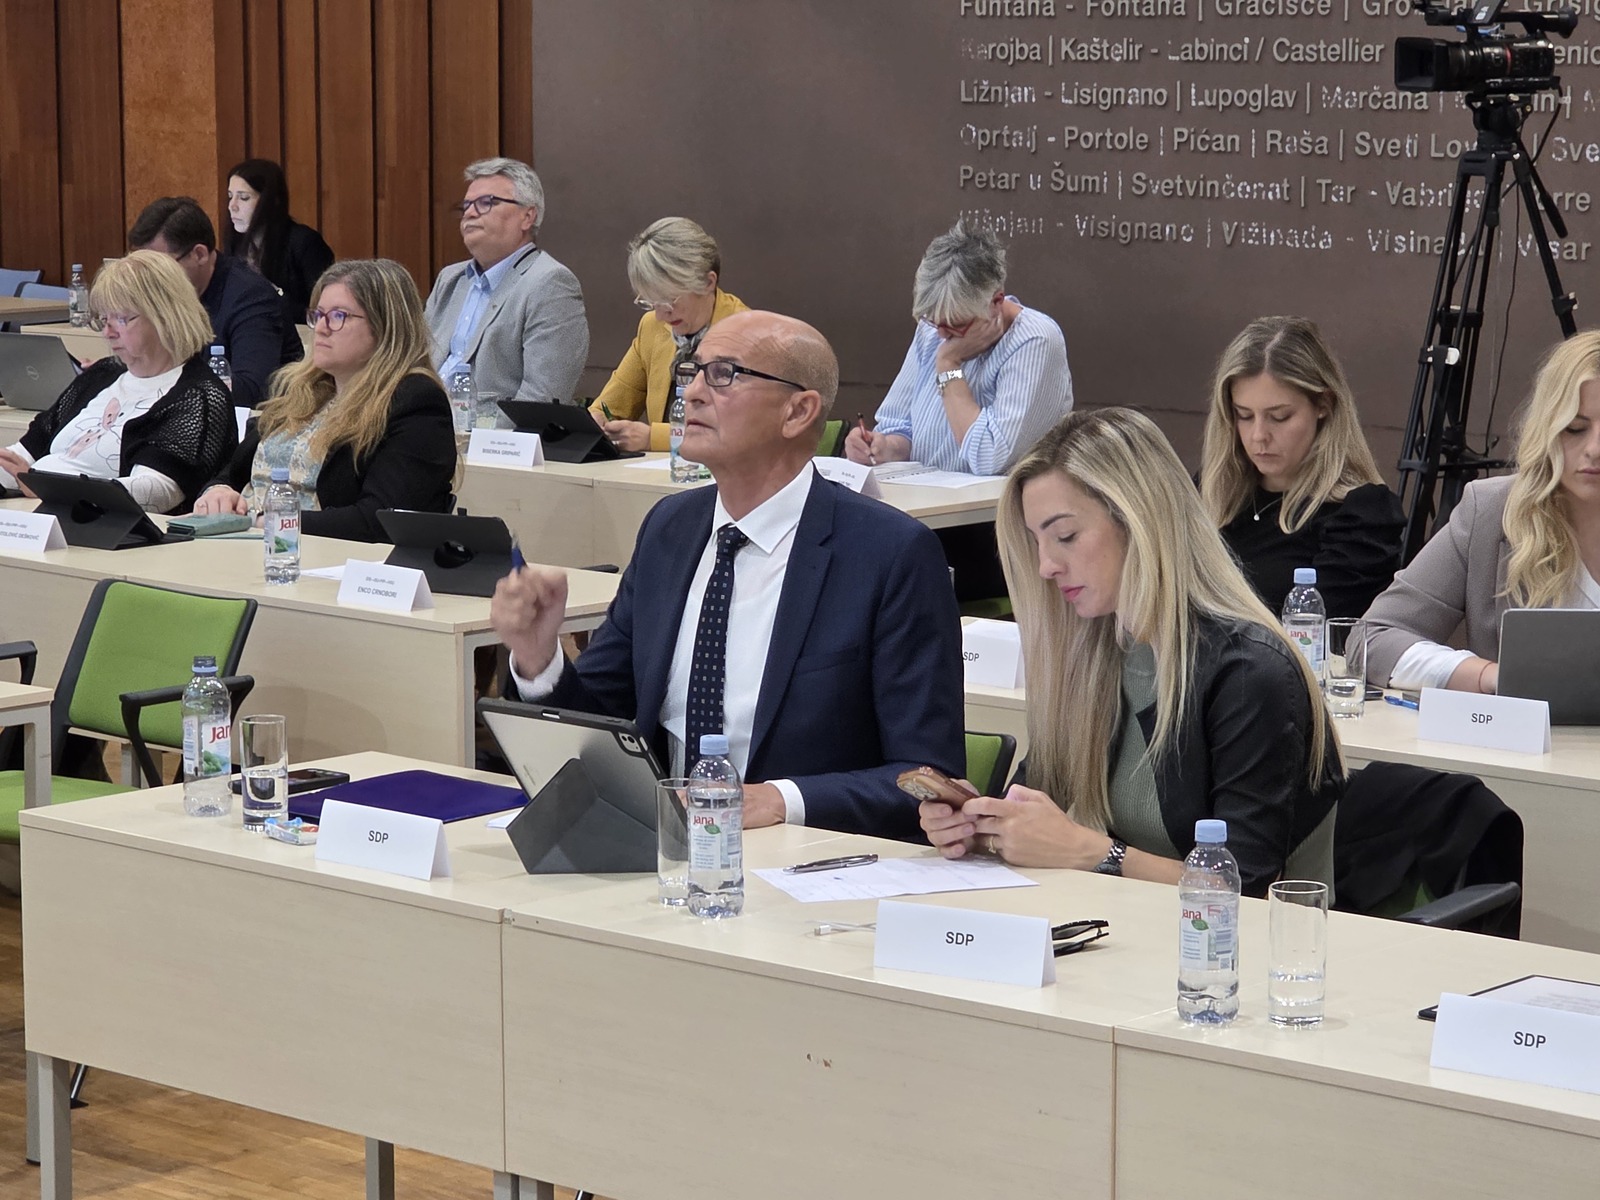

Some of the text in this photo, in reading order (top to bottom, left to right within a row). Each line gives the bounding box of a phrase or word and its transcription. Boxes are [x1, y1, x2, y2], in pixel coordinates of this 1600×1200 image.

[1087, 0, 1186, 16] Fontana
[1061, 37, 1143, 61] Kaštelir
[1273, 37, 1385, 63] Castellier
[960, 80, 1036, 107] Ližnjan
[1061, 82, 1168, 110] Lisignano
[1191, 83, 1297, 113] Lupoglav
[1322, 85, 1429, 110] Marčana
[960, 123, 1037, 153] Oprtalj
[1064, 126, 1149, 150] Portole
[1173, 127, 1240, 152] Pićan
[1266, 129, 1328, 155] Raša
[1355, 131, 1418, 158] Sveti
[959, 165, 1020, 189] Petar
[1029, 173, 1041, 190] u
[1050, 161, 1108, 193] Šumi
[1132, 171, 1290, 201] Svetvinčenat
[1316, 179, 1356, 203] Tar
[1075, 214, 1194, 244] Visignano
[963, 651, 980, 662] SDP
[1471, 713, 1493, 725] SDP
[368, 830, 389, 844] SDP
[945, 931, 975, 946] SDP
[1513, 1031, 1547, 1049] SDP
